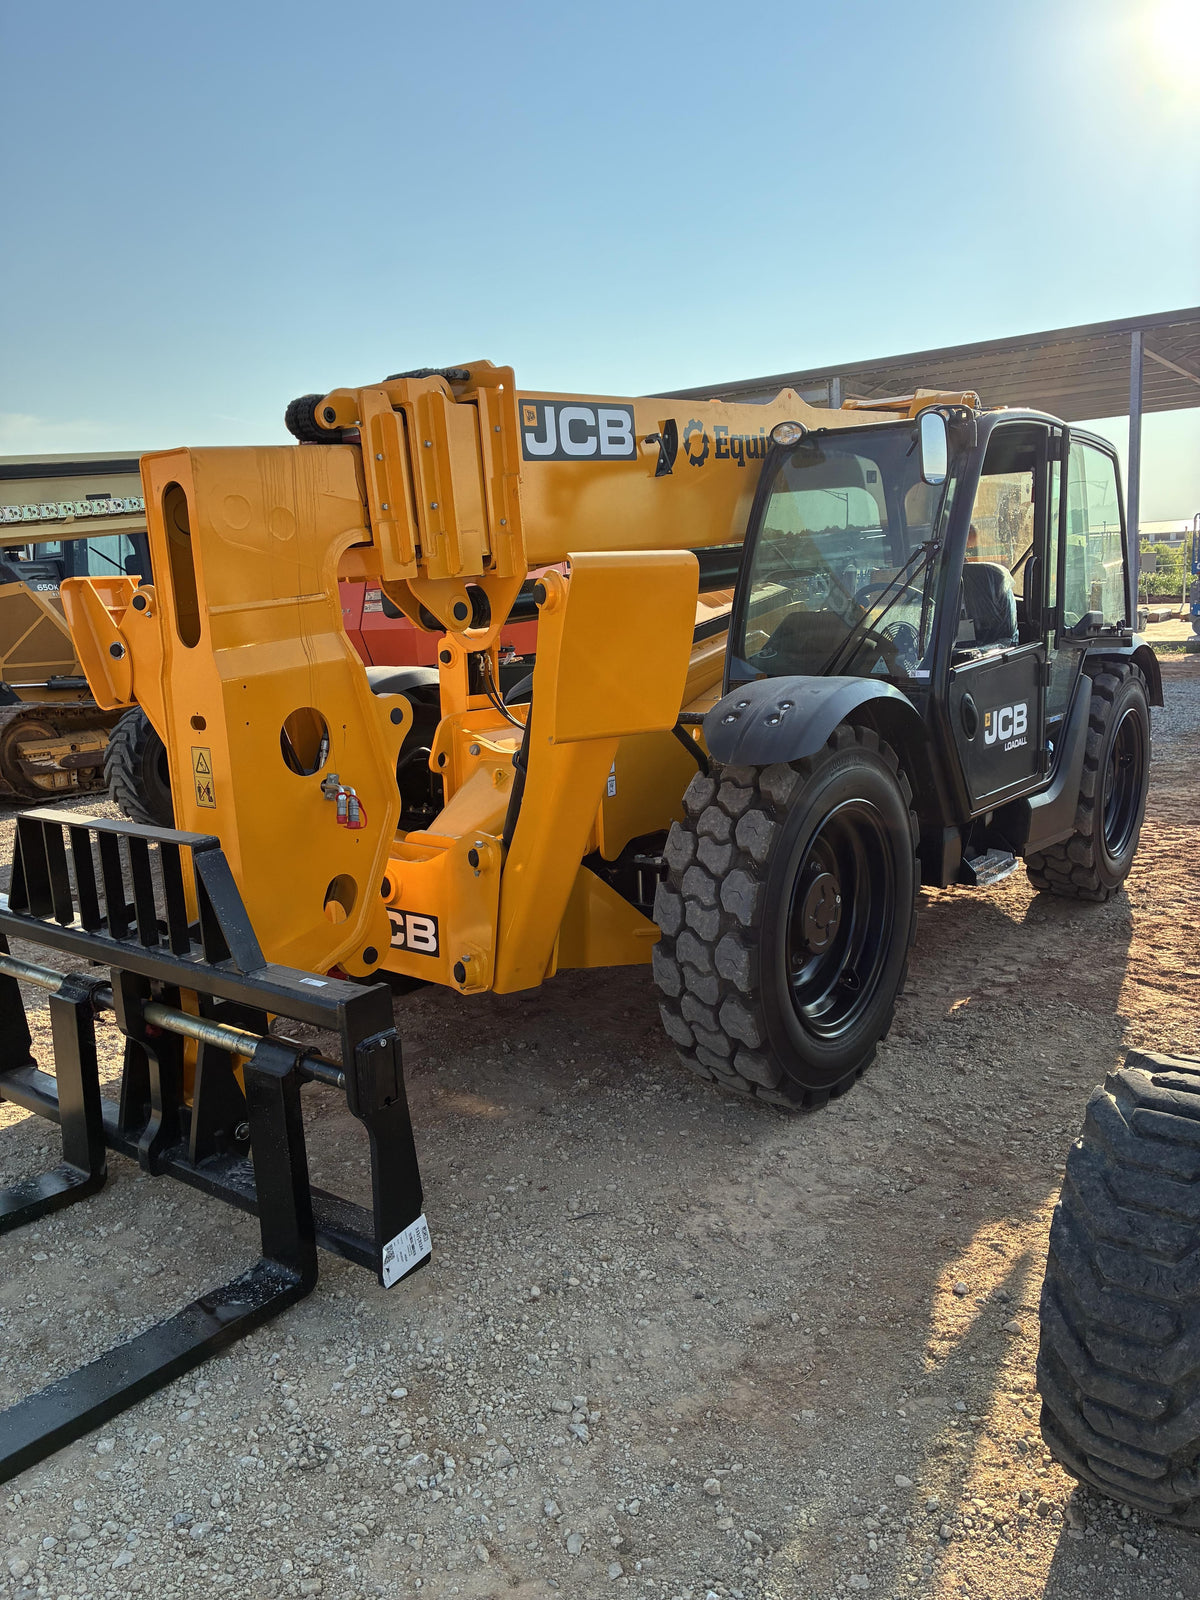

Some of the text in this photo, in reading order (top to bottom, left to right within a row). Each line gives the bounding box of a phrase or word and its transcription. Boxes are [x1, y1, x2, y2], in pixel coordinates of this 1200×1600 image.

[525, 406, 634, 456] JCB
[713, 425, 770, 467] Equi
[984, 703, 1027, 745] JCB
[1004, 737, 1028, 752] LOADALL
[387, 910, 437, 952] CB
